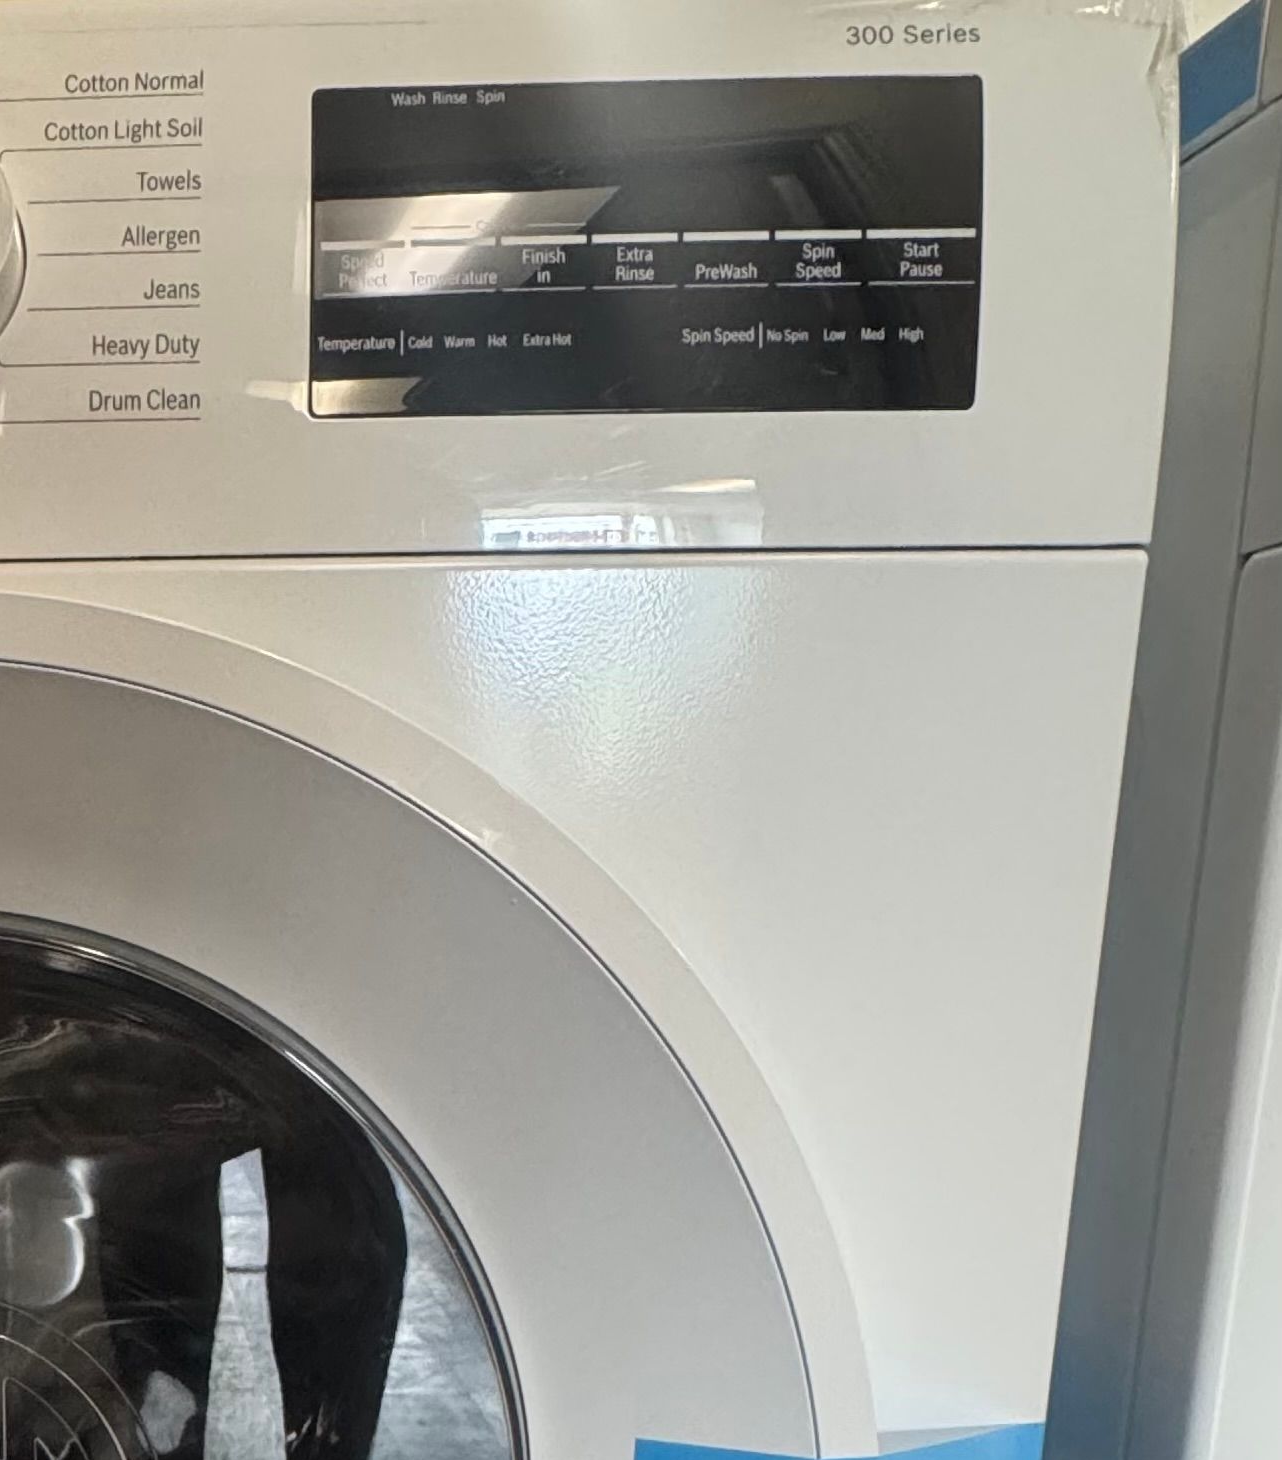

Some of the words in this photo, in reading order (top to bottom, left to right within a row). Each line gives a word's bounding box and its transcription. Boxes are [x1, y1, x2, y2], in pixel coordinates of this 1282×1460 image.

[846, 25, 894, 45] 300
[903, 23, 981, 44] Series
[64, 74, 128, 93] Cotton
[135, 70, 204, 90] Normal
[390, 92, 426, 106] Wash
[433, 91, 468, 105] Rinse
[476, 89, 505, 106] Spin
[44, 122, 108, 141] Cotton
[114, 119, 162, 143] Light
[167, 117, 203, 138] Soil
[136, 169, 202, 191] Towels
[121, 226, 201, 249] Allergen
[522, 249, 566, 266] Finish
[617, 246, 653, 262] Extra
[802, 242, 835, 261] Spin
[903, 242, 939, 258] Start
[340, 252, 384, 271] Spd
[796, 261, 842, 280] Speed
[899, 261, 943, 278] Pause
[339, 272, 387, 288] Peect
[537, 269, 550, 283] in
[615, 266, 654, 281] Rinse
[695, 263, 757, 281] PreWash
[143, 278, 200, 301] Jeans
[318, 335, 396, 353] Temperature
[408, 334, 433, 349] Cold
[444, 334, 476, 348] Warm
[487, 334, 507, 348] Hot
[522, 333, 550, 347] Extra
[552, 333, 572, 347] Hot
[681, 328, 711, 346] Spin
[714, 328, 754, 346] Speed
[767, 329, 782, 342] No
[784, 328, 809, 345] Spin
[823, 328, 846, 342] Low
[861, 328, 885, 342] Med
[898, 327, 924, 344] High
[92, 335, 149, 360] Heavy
[155, 333, 200, 358] Duty
[89, 390, 141, 412] Drum
[146, 388, 201, 411] Clean
